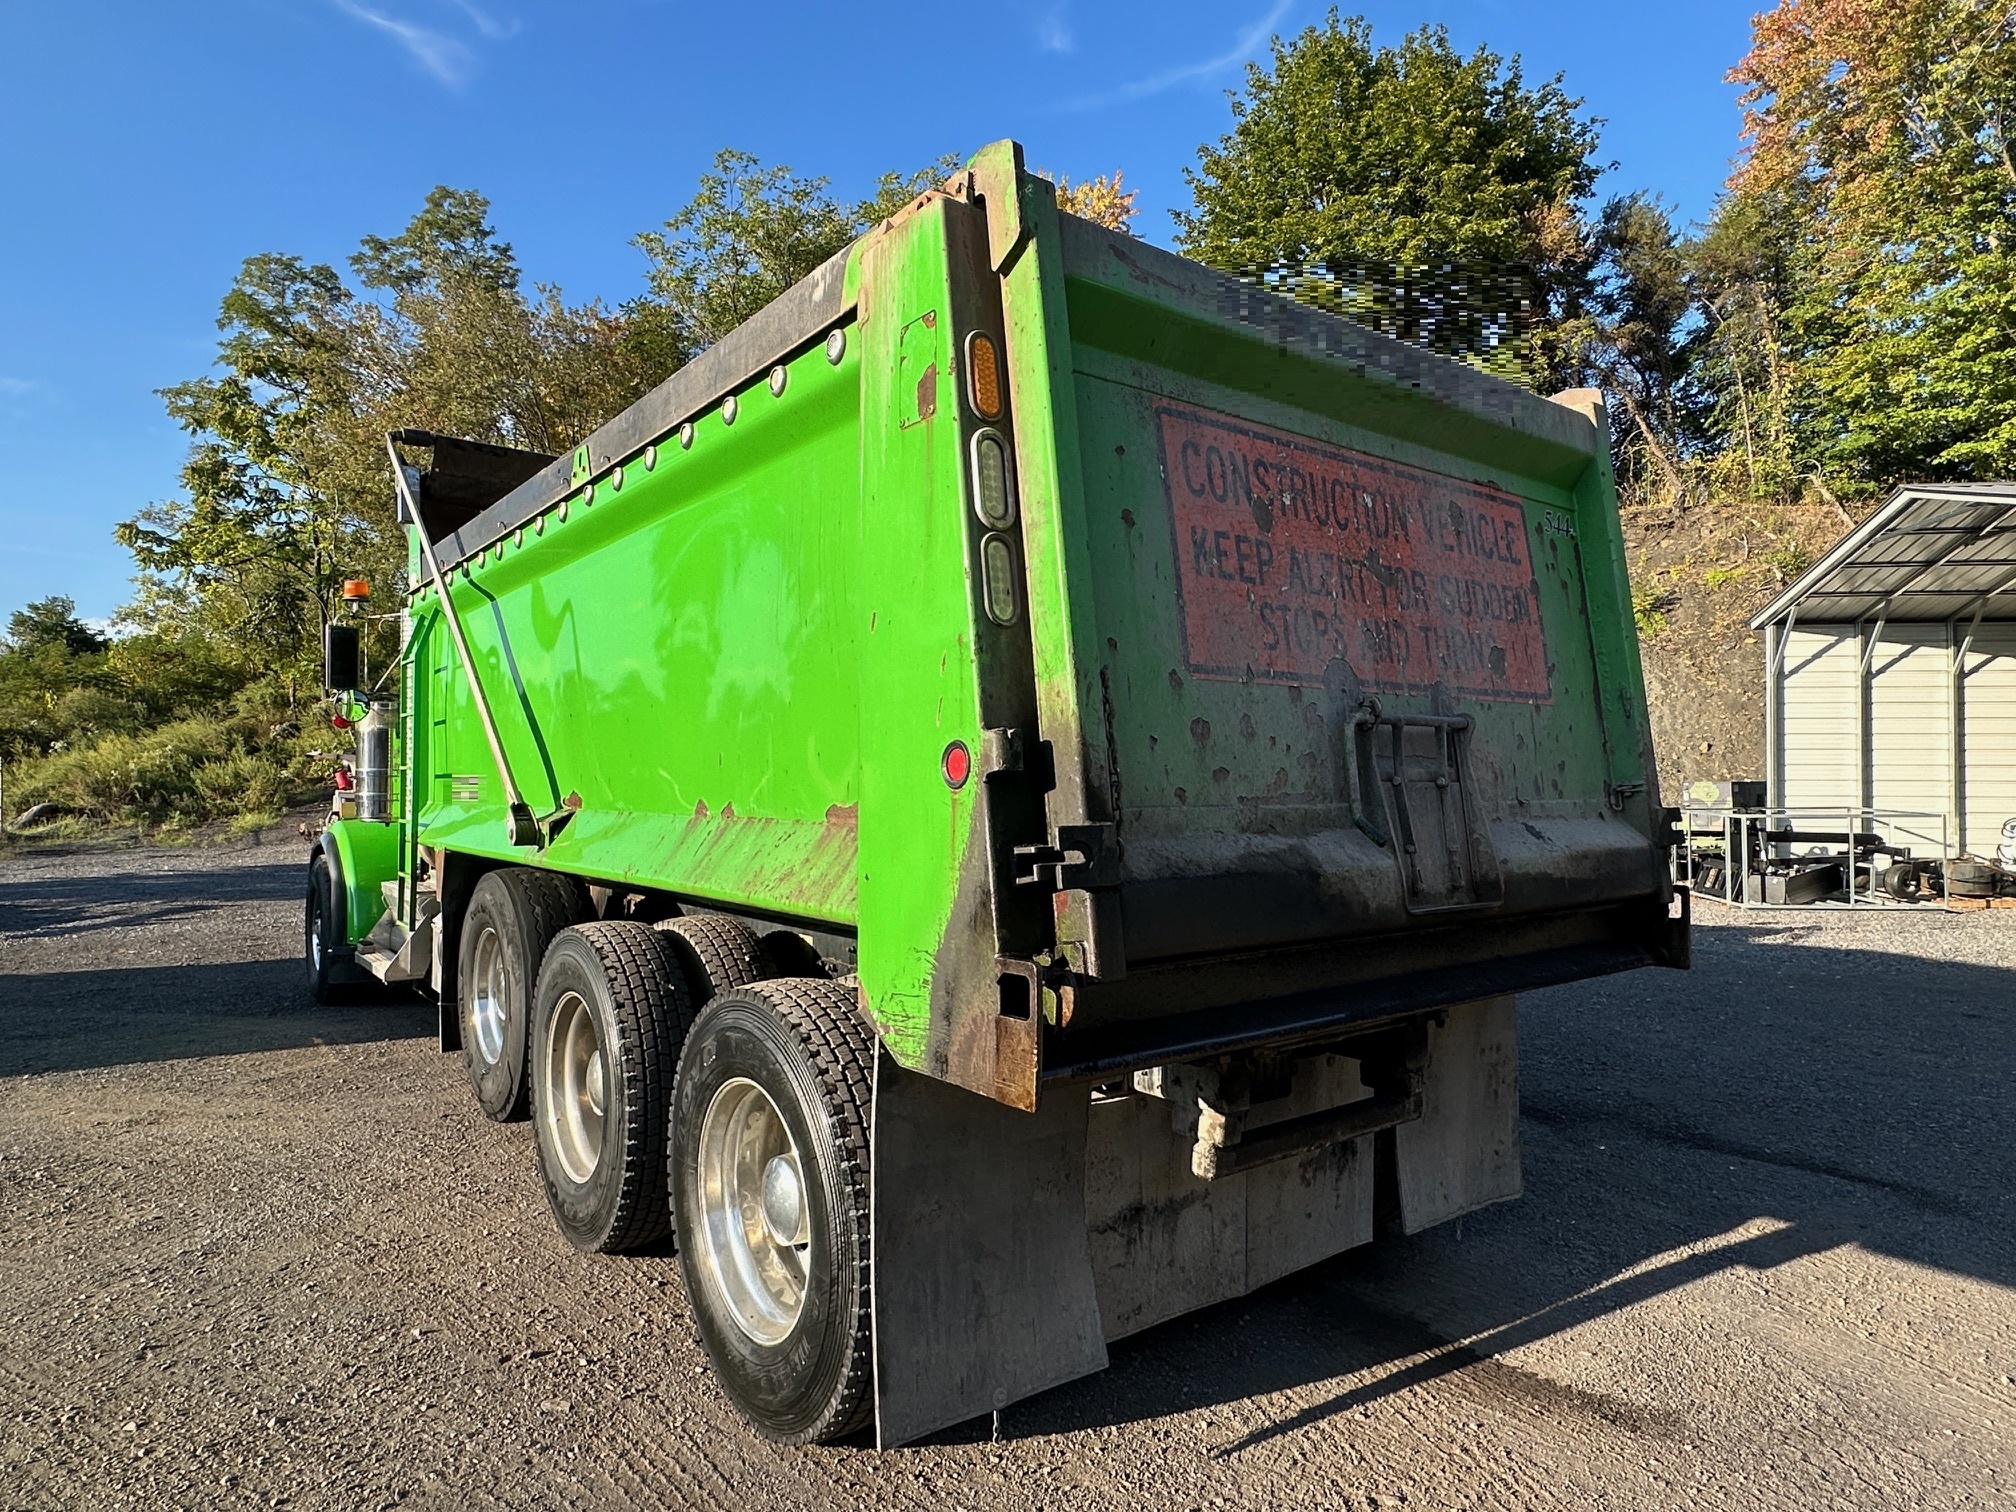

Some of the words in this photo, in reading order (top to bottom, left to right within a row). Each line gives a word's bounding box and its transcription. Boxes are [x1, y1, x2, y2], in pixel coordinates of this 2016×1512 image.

[1181, 439, 1411, 544] CONSTRUCTION
[1418, 498, 1522, 566] VEHICLE
[1191, 525, 1274, 586] KEEP
[1288, 545, 1366, 604] ALERT
[1438, 573, 1533, 627] SUDDEN
[1260, 600, 1348, 659] STOPS
